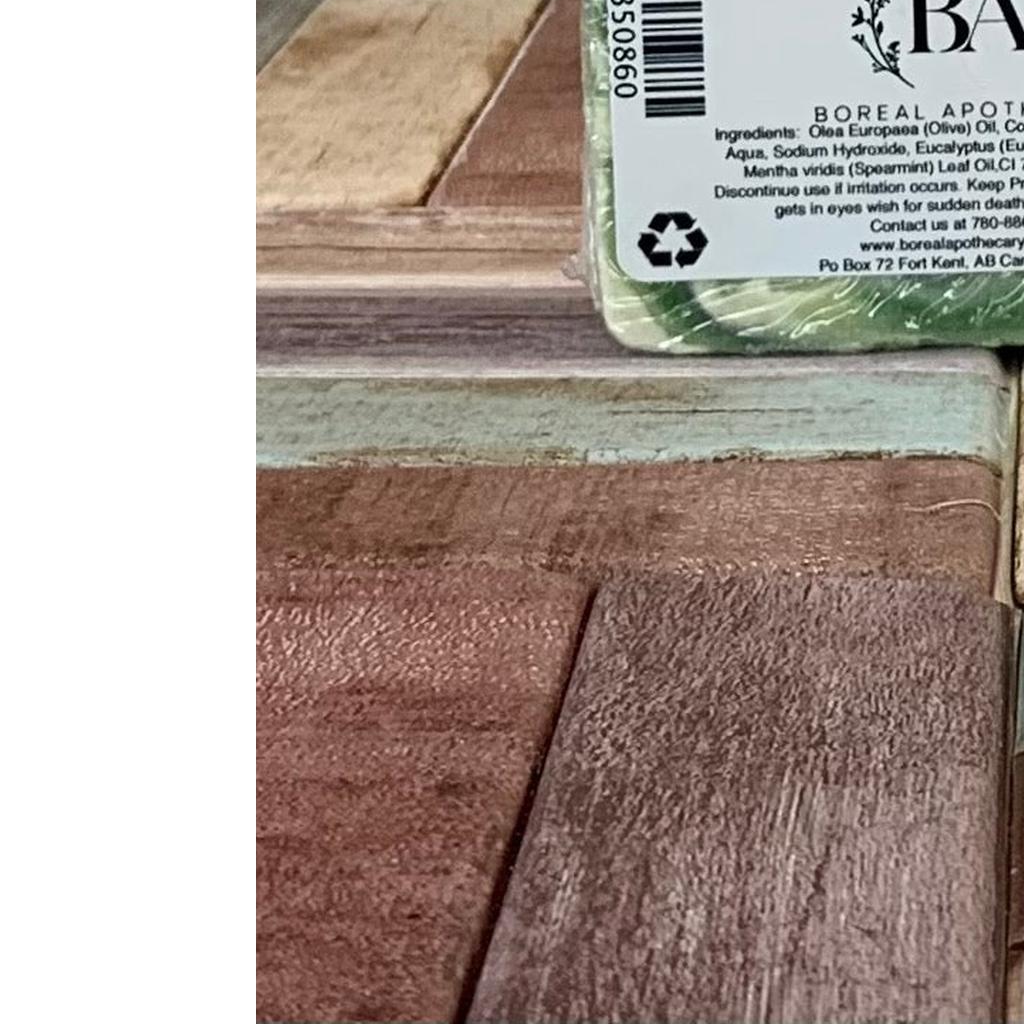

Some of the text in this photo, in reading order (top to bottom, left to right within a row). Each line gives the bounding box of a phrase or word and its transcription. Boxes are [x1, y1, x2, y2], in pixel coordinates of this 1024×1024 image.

[813, 104, 925, 123] BOREAL
[715, 127, 800, 144] Ingredients:
[809, 123, 844, 138] Olea
[848, 123, 919, 139] Europaea
[923, 120, 971, 137] (Olive)
[975, 119, 1000, 135] Oil,
[725, 146, 769, 163] Aqua,
[773, 144, 828, 160] Sodium
[833, 142, 910, 160] Hydroxide,
[916, 139, 995, 157] Eucalyptus
[743, 164, 798, 178] Mentha
[802, 162, 844, 177] viridis
[849, 160, 934, 178] (Spearmint)
[938, 159, 970, 174] Leaf
[714, 183, 800, 199] Discontinue
[804, 184, 830, 196] use
[834, 181, 843, 195] if
[847, 180, 905, 195] irritation
[967, 177, 1005, 194] Keep
[774, 203, 806, 219] gets
[810, 202, 823, 215] in
[827, 202, 863, 218] eyes
[867, 199, 900, 214] wish
[903, 198, 923, 213] for
[927, 197, 980, 212] sudden
[870, 217, 927, 233] Contact
[931, 220, 949, 232] us
[953, 218, 967, 231] at
[819, 258, 839, 273] Po
[843, 257, 871, 272] Box
[875, 257, 894, 271] 72
[899, 256, 927, 271] Fort
[973, 253, 996, 268] AB
